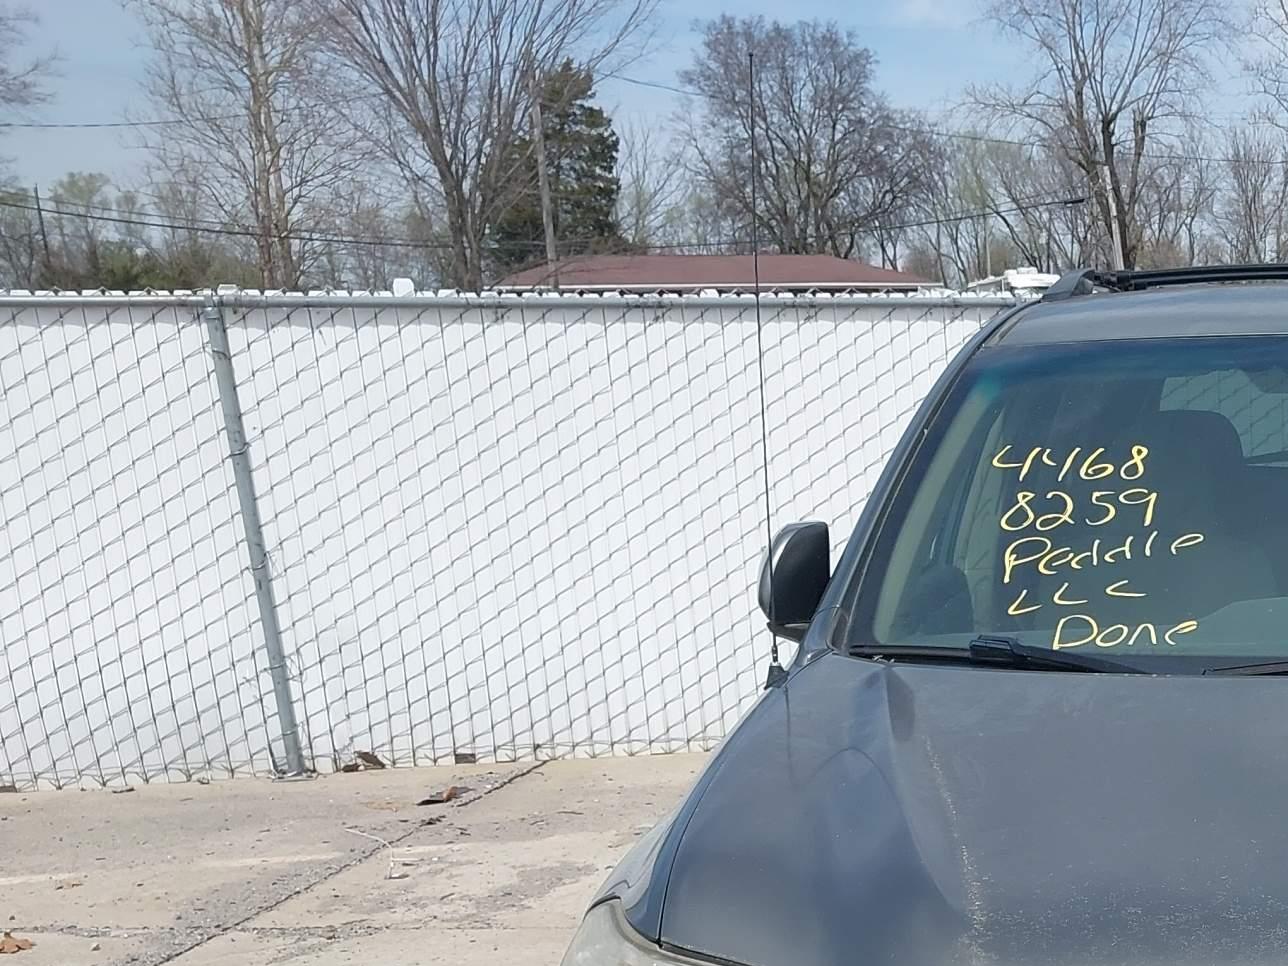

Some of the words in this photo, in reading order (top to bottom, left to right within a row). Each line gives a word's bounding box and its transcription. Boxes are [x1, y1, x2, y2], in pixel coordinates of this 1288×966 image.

[992, 445, 1149, 482] 4468
[1000, 488, 1158, 531] 8259
[1052, 614, 1199, 651] Done
